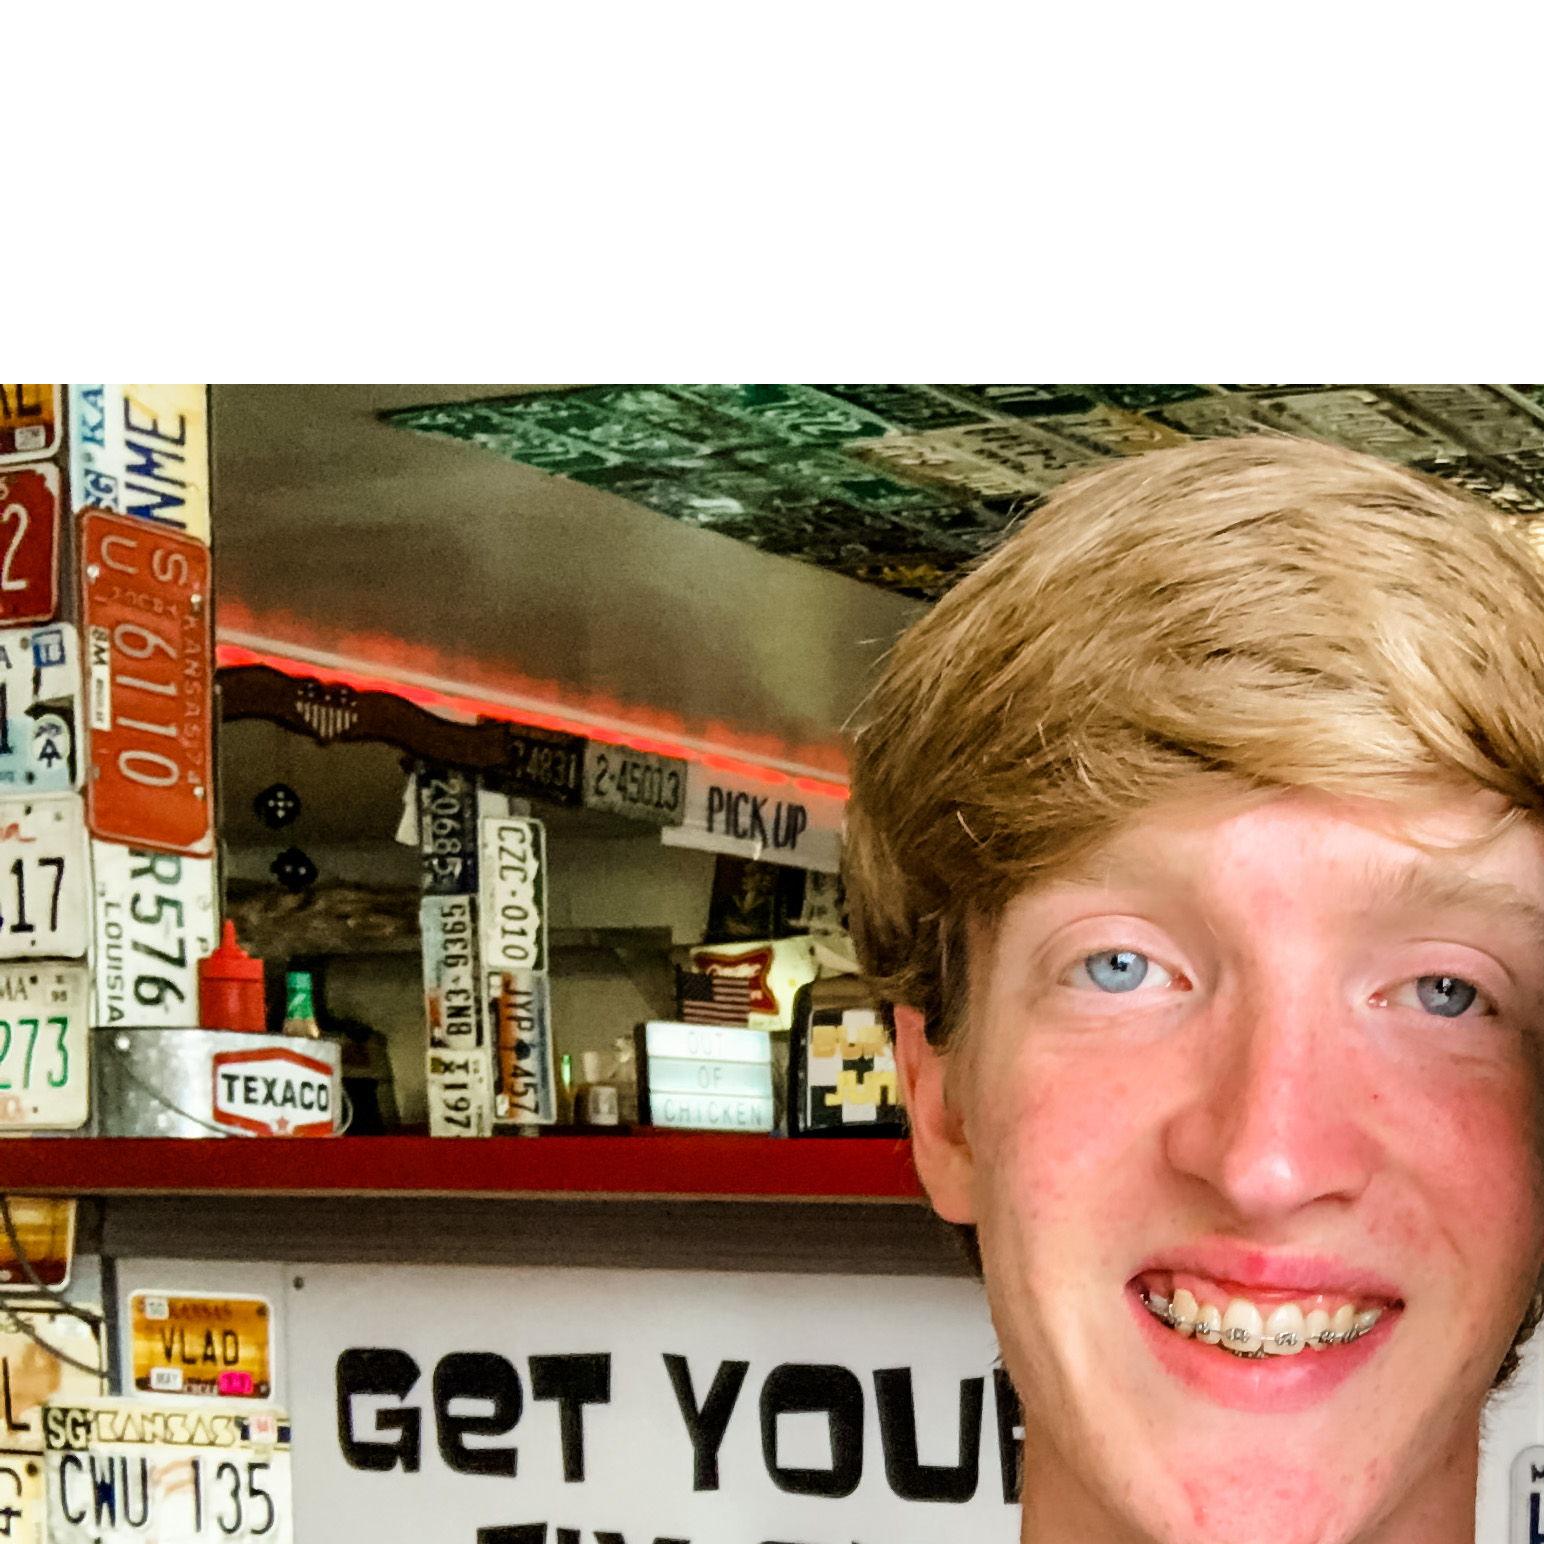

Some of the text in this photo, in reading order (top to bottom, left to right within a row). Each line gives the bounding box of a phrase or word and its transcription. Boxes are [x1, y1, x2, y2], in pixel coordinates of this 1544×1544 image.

[124, 396, 187, 530] NME
[113, 622, 180, 787] 6110
[431, 777, 462, 876] 20685
[707, 785, 807, 850] PICK UP
[0, 857, 65, 933] 17
[221, 1073, 330, 1113] TEXACO
[443, 1082, 471, 1129] 197
[510, 1063, 540, 1115] 457
[697, 1064, 723, 1089] OF
[663, 1097, 763, 1126] CHICKEN
[161, 1326, 239, 1366] VLAD
[94, 1410, 237, 1447] KANSAS
[662, 1353, 1026, 1506] YOU
[60, 1455, 150, 1528] CWU
[191, 1458, 276, 1535] 135
